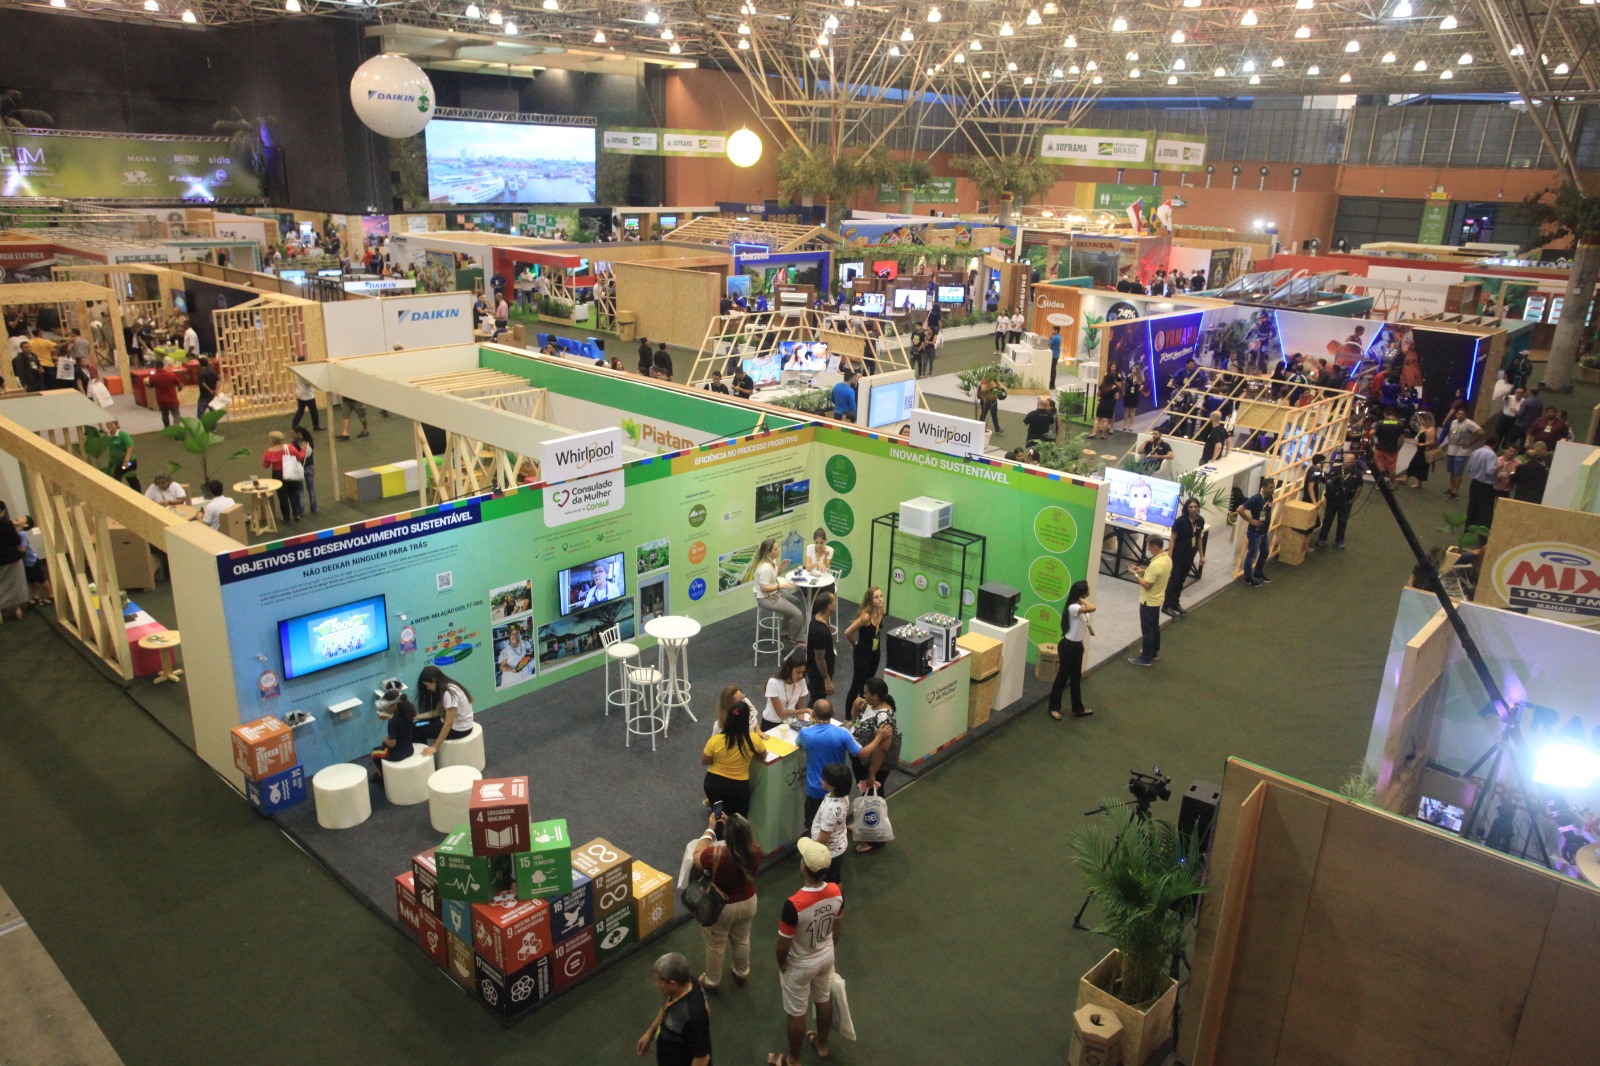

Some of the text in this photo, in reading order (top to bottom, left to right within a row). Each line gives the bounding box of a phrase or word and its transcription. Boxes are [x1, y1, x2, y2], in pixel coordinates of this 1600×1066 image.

[377, 92, 414, 102] DAIKIN
[1056, 142, 1088, 152] SUFRAMA
[1113, 146, 1138, 155] BRASIL
[1076, 240, 1114, 248] HONDA
[15, 252, 44, 260] ELÉTRICA
[740, 252, 770, 261] SAMSUNG
[1038, 296, 1064, 308] Midea
[411, 308, 460, 322] DAIKIN
[1118, 308, 1136, 318] 74%
[1166, 326, 1198, 348] YAMAHA
[642, 424, 694, 449] Piatam
[918, 421, 972, 444] Whirlpool
[556, 440, 614, 466] Whirlpool
[694, 452, 728, 466] EFICIÊNCIA
[728, 448, 737, 458] NO
[738, 442, 767, 456] PROCESSO
[890, 447, 1009, 484] INOVAÇÃO SUSTENTÁVEL
[572, 480, 612, 496] Consulado
[572, 490, 612, 504] da Mulher
[232, 510, 472, 576] OBJETIVOS DE DESENVOLVIMENTO SUSTENTÁVEL
[302, 567, 320, 578] NÃO
[322, 560, 351, 575] DEIXAR
[352, 550, 388, 568] NINGUÉM
[389, 546, 408, 558] PARA
[409, 541, 428, 553] TRÁS
[1506, 560, 1600, 594] MIX
[1518, 589, 1600, 606] 100.7 FM
[1536, 603, 1576, 613] MANAUS
[414, 608, 454, 624] INTER-RELAÇÃO
[477, 812, 483, 823] 4
[439, 856, 445, 867] 3
[520, 856, 530, 868] 15
[596, 877, 604, 889] 12
[553, 901, 562, 913] 16
[814, 904, 832, 917] ZICO
[507, 927, 513, 938] 9
[596, 921, 604, 933] 13
[806, 912, 835, 948] 10
[555, 946, 564, 958] 10
